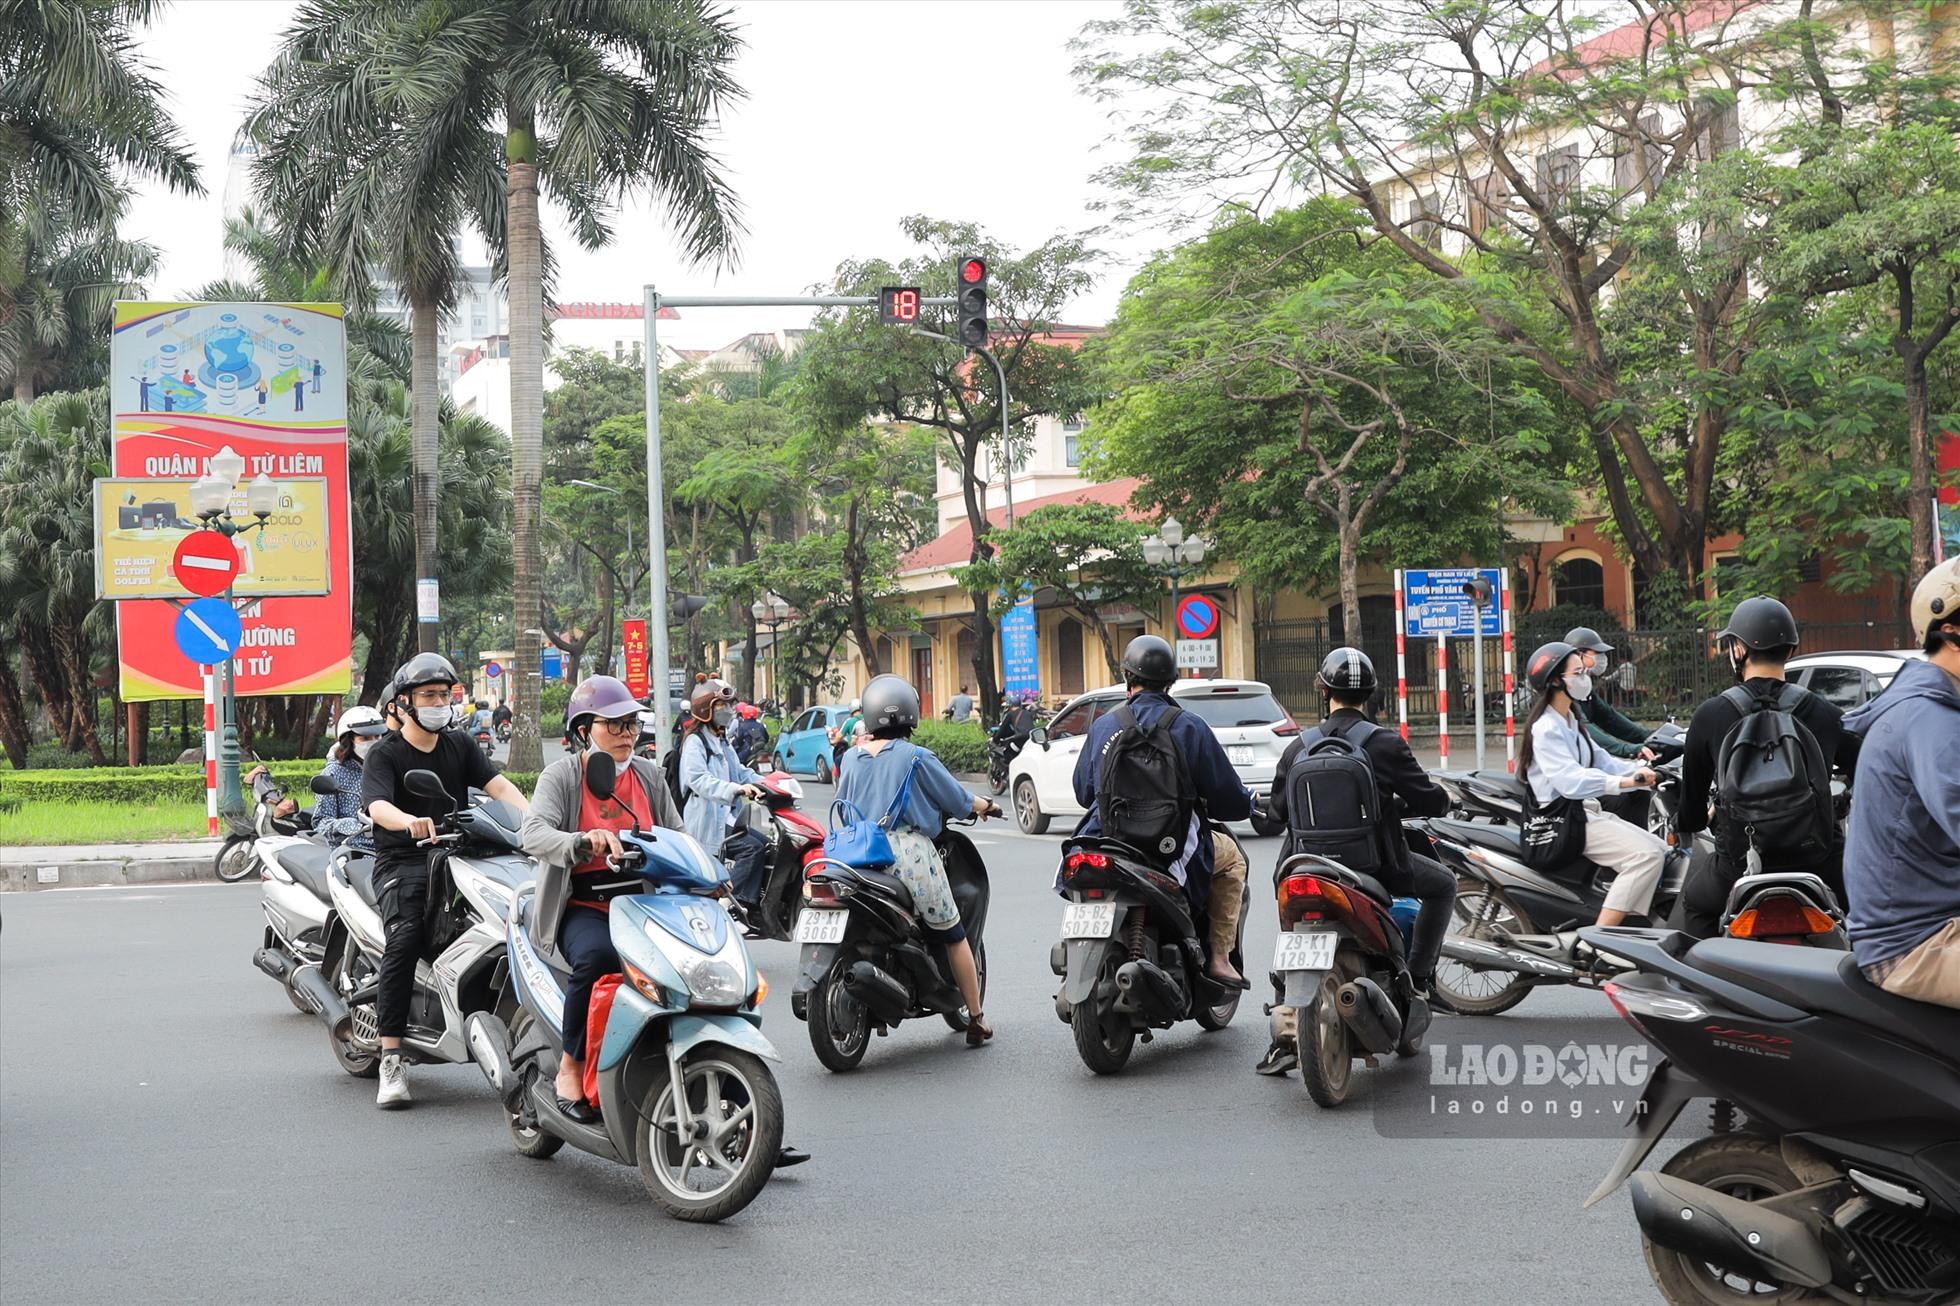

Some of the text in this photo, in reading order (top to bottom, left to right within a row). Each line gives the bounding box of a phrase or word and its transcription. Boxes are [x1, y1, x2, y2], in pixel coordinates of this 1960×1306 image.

[557, 302, 669, 320] AGRIBAK
[894, 291, 916, 320] 18
[145, 453, 197, 476] QUẬN
[251, 452, 275, 474] TỪ
[279, 452, 323, 473] LIÊM
[248, 650, 273, 676] TỬ
[1073, 905, 1108, 920] 15-B2
[802, 927, 838, 940] 3060
[1285, 935, 1328, 950] 29-K1
[515, 936, 533, 970] CLICK
[1280, 951, 1330, 968] 128.71
[1712, 1039, 1763, 1056] SPECIAL
